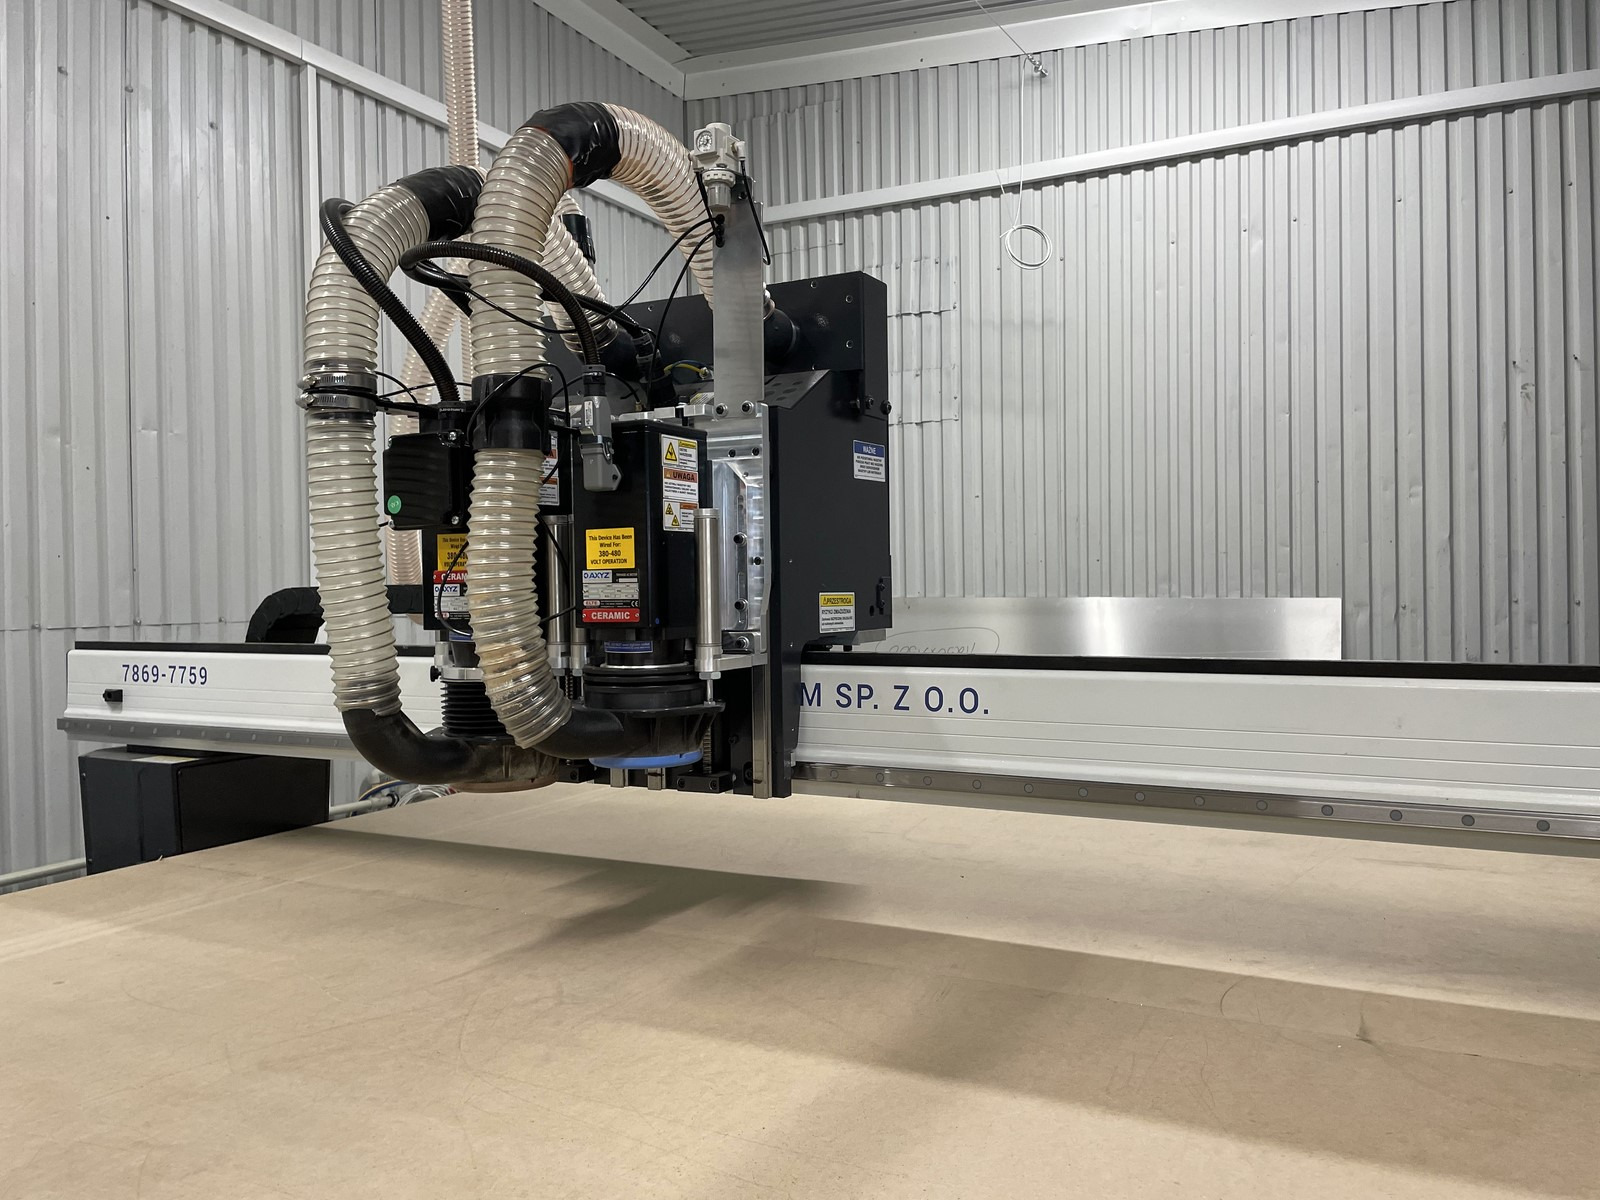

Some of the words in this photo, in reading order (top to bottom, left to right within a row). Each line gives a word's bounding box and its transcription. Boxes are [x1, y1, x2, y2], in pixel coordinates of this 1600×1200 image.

[672, 470, 695, 481] UWAGA
[591, 612, 630, 620] CERAMIC
[122, 664, 208, 685] 7869-7759
[835, 683, 879, 709] SP.
[893, 685, 910, 711] Z
[924, 686, 989, 715] O.O.
